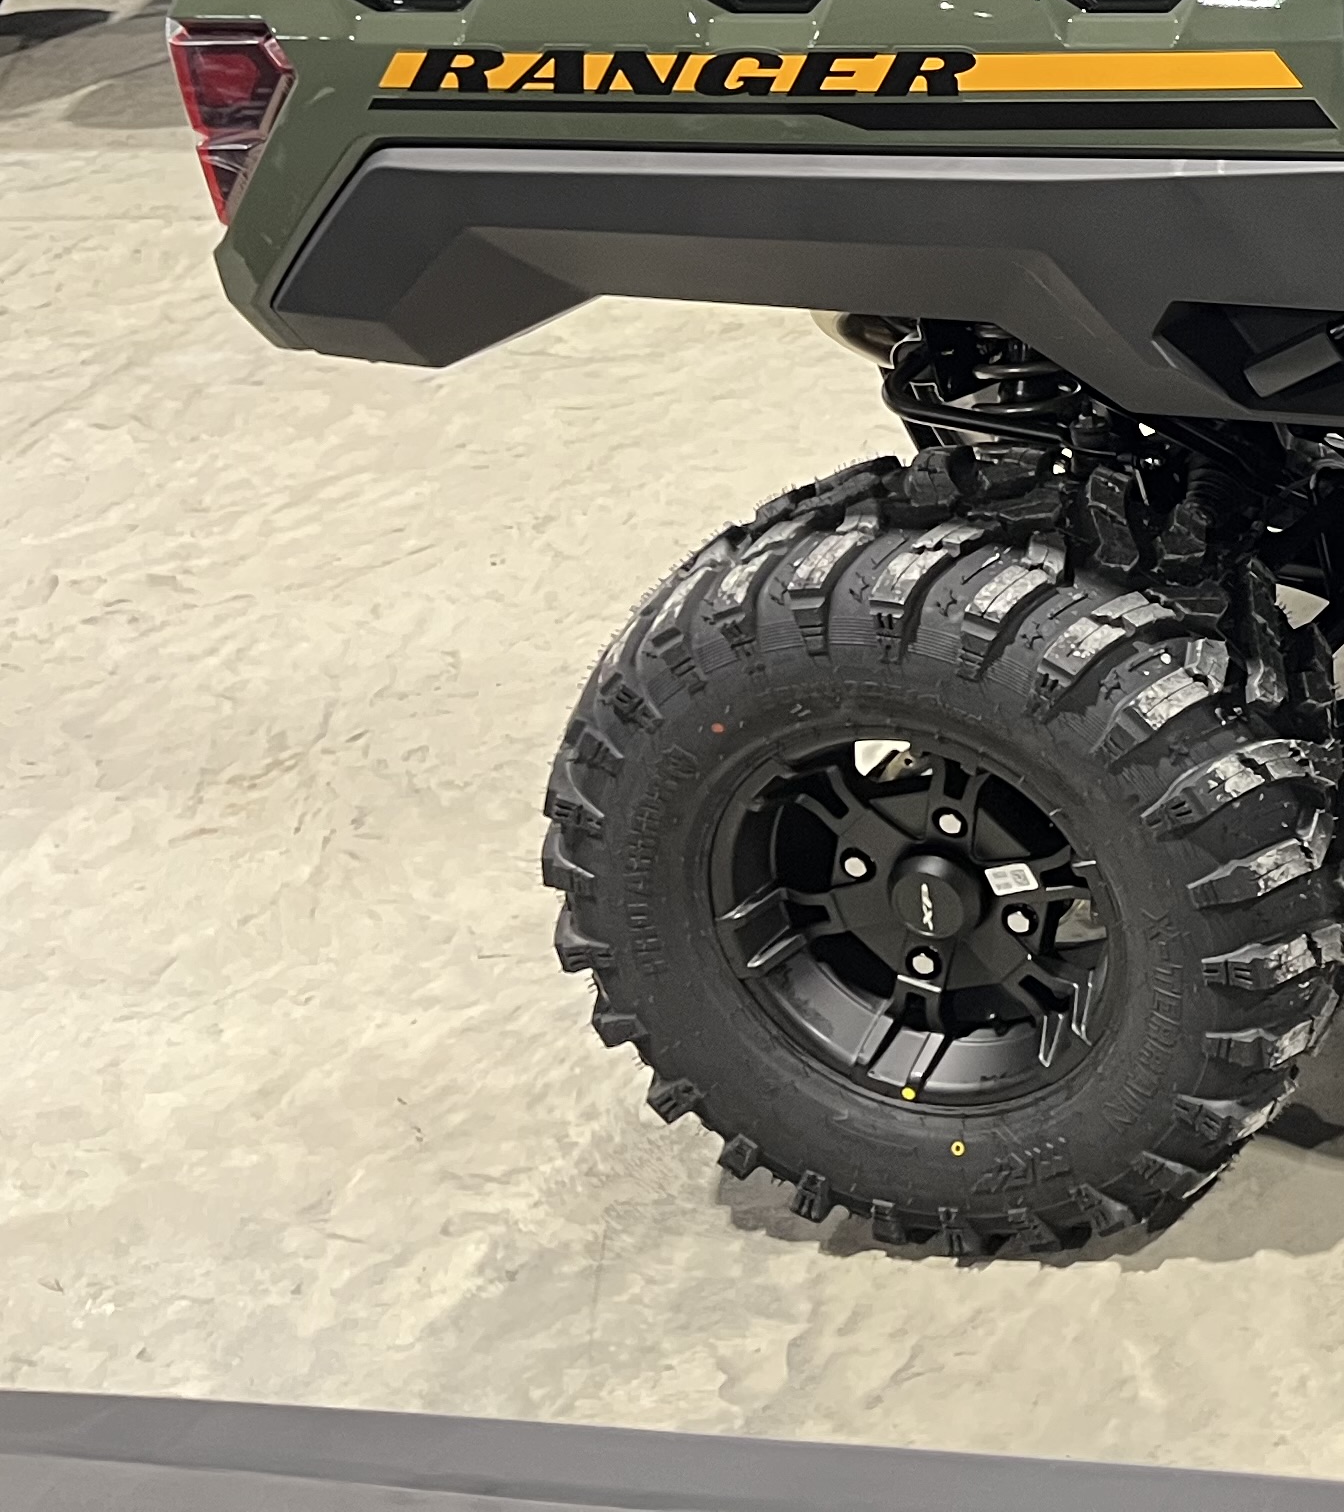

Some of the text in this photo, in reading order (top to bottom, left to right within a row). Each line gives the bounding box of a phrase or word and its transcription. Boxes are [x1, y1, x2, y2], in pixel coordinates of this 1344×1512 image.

[405, 47, 979, 97] RANGER
[920, 882, 935, 932] XP
[1101, 906, 1187, 1136] X-TERRAIN
